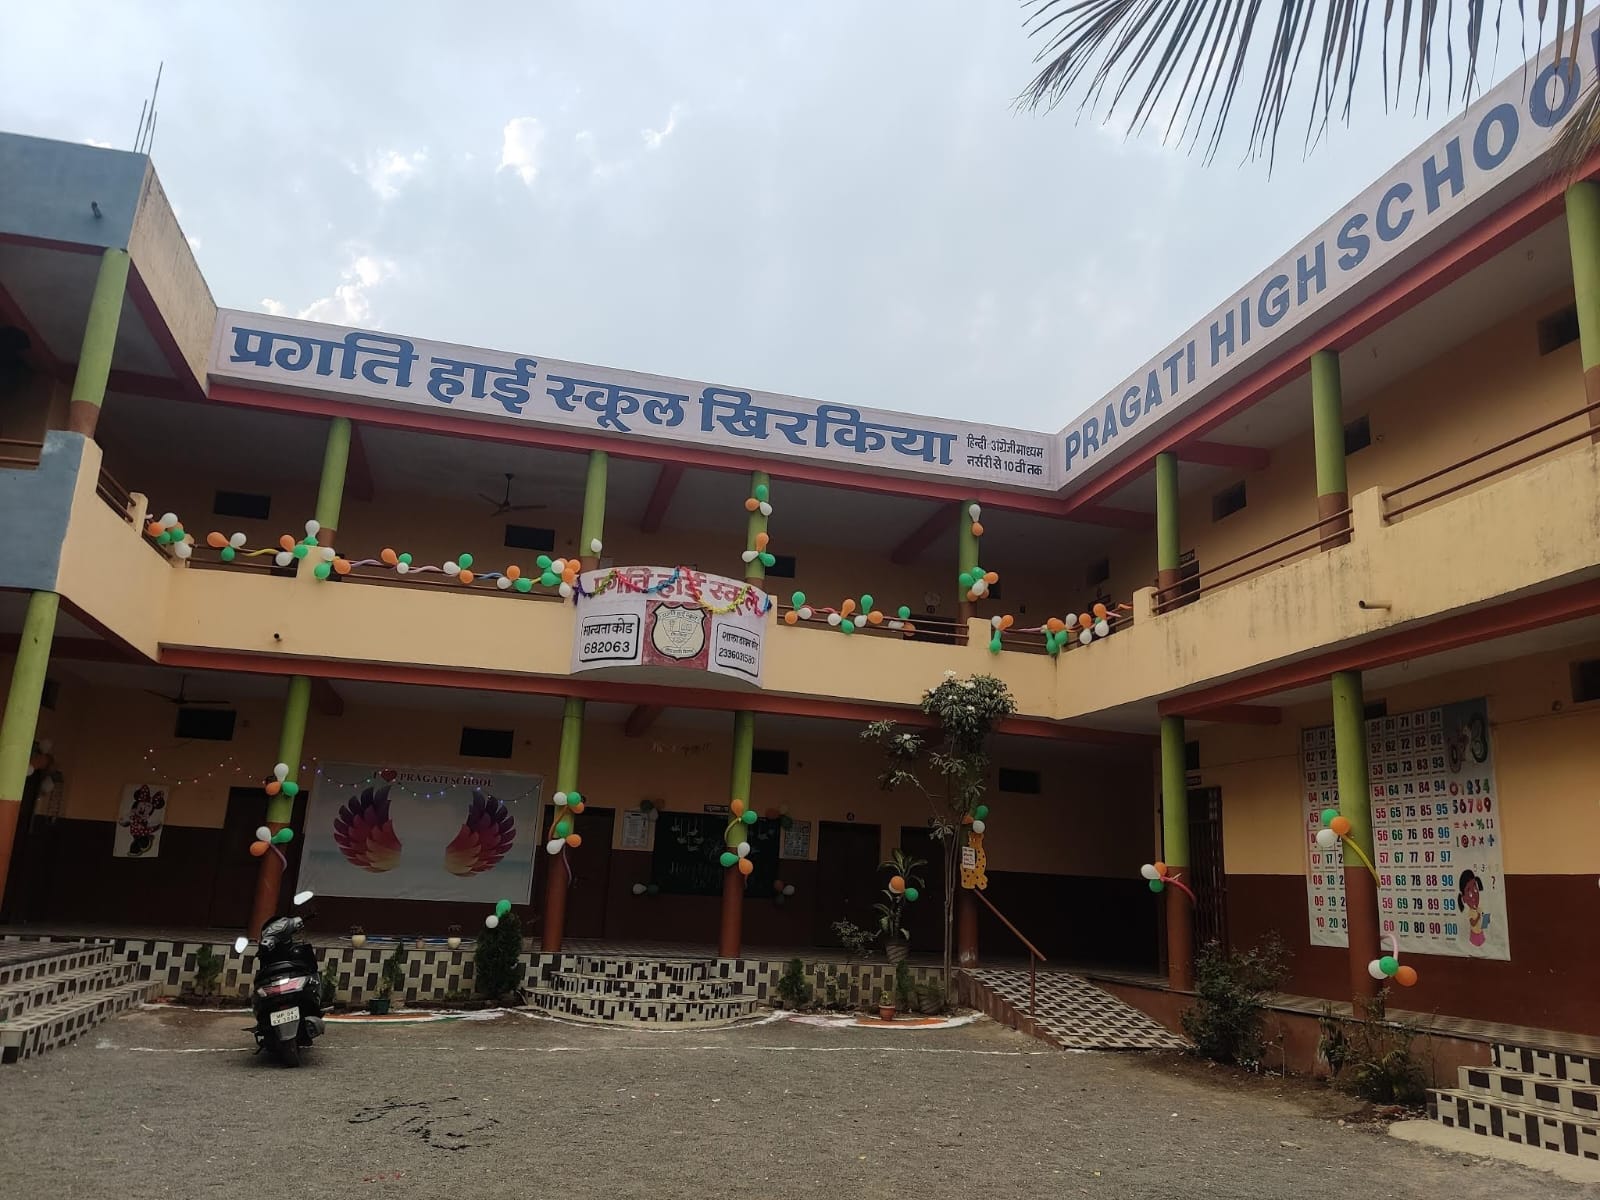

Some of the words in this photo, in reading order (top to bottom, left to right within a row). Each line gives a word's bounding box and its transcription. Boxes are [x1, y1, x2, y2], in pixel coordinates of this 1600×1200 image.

[1065, 341, 1196, 472] PRAGATI
[1210, 241, 1326, 366] HIGH
[1338, 17, 1600, 272] SCHOO
[230, 326, 418, 387] प्रगति
[426, 357, 537, 414] हाई
[547, 375, 689, 432] स्कूल
[699, 387, 957, 466] खिरकिया
[1027, 464, 1043, 475] तक
[611, 618, 635, 634] कोड
[584, 641, 630, 654] 682063
[1371, 742, 1381, 753] 52
[1385, 740, 1396, 752] 62
[1401, 738, 1410, 749] 72
[1415, 736, 1426, 747] 82
[1430, 733, 1442, 745] 92
[1373, 764, 1383, 775] 53
[1387, 762, 1398, 774] 63
[1402, 761, 1412, 772] 73
[1417, 758, 1428, 770] 83
[1432, 757, 1444, 768] 93
[1308, 792, 1317, 802] 04
[1321, 791, 1329, 801] 14
[1374, 785, 1384, 797] 54
[1388, 785, 1399, 796] 64
[1403, 783, 1413, 794] 74
[1419, 781, 1429, 793] 84
[1434, 780, 1445, 791] 94
[1310, 813, 1319, 823] 05
[1376, 808, 1386, 818] 55
[1390, 807, 1401, 818] 65
[1405, 806, 1416, 817] 75
[1420, 805, 1431, 816] 85
[1436, 803, 1448, 815] 95
[1377, 830, 1388, 841] 56
[1392, 829, 1402, 841] 66
[1407, 829, 1417, 840] 76
[1422, 827, 1433, 839] 86
[1438, 827, 1449, 839] 96
[1312, 854, 1320, 864] 07
[1326, 854, 1333, 864] 17
[1379, 852, 1388, 863] 57
[1394, 852, 1404, 863] 67
[1409, 851, 1418, 863] 77
[1425, 851, 1434, 863] 87
[1441, 850, 1451, 862] 97
[1313, 875, 1323, 885] 08
[1326, 875, 1335, 885] 18
[1380, 874, 1391, 886] 58
[1395, 875, 1406, 886] 68
[1411, 875, 1421, 886] 78
[1426, 874, 1438, 886] 88
[1441, 874, 1454, 887] 98
[1314, 895, 1324, 906] 09
[1328, 896, 1336, 907] 19
[1382, 898, 1393, 909] 59
[1397, 898, 1408, 909] 69
[1412, 898, 1423, 910] 79
[1427, 898, 1439, 910] 89
[1443, 898, 1456, 911] 99
[1316, 917, 1325, 928] 10
[1329, 917, 1338, 928] 20
[1383, 920, 1394, 932] 60
[1399, 921, 1409, 933] 70
[1413, 921, 1425, 934] 80
[1429, 922, 1441, 934] 90
[1444, 923, 1458, 935] 100
